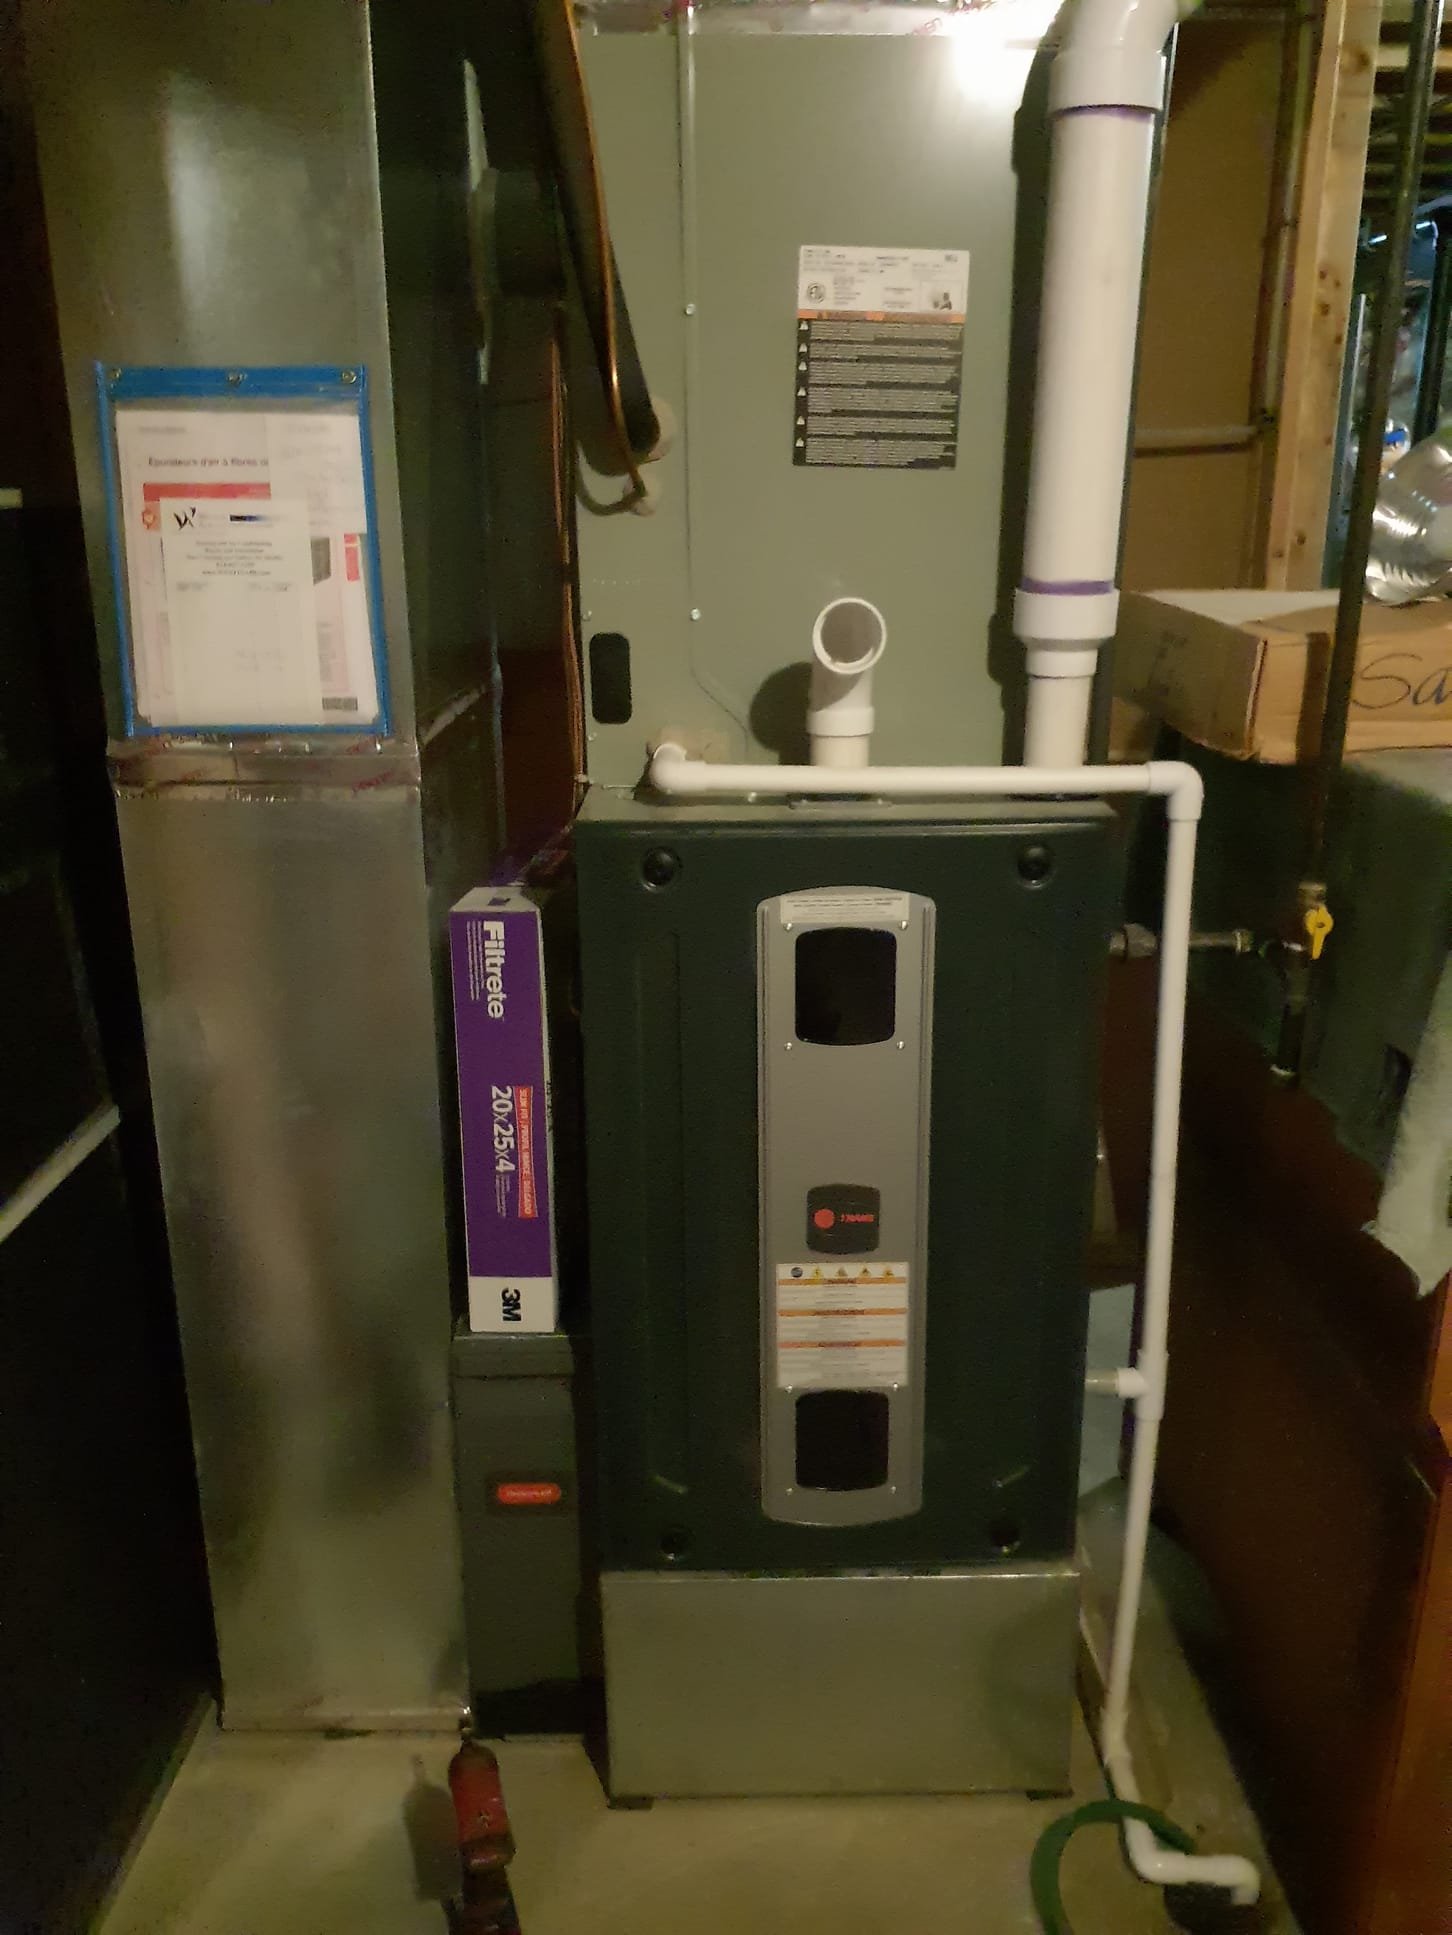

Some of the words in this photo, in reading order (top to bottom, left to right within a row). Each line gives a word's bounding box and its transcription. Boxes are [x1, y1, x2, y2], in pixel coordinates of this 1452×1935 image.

[484, 920, 506, 1018] Filtrete
[491, 1085, 516, 1172] 20x25x4
[501, 1288, 522, 1322] 3M
